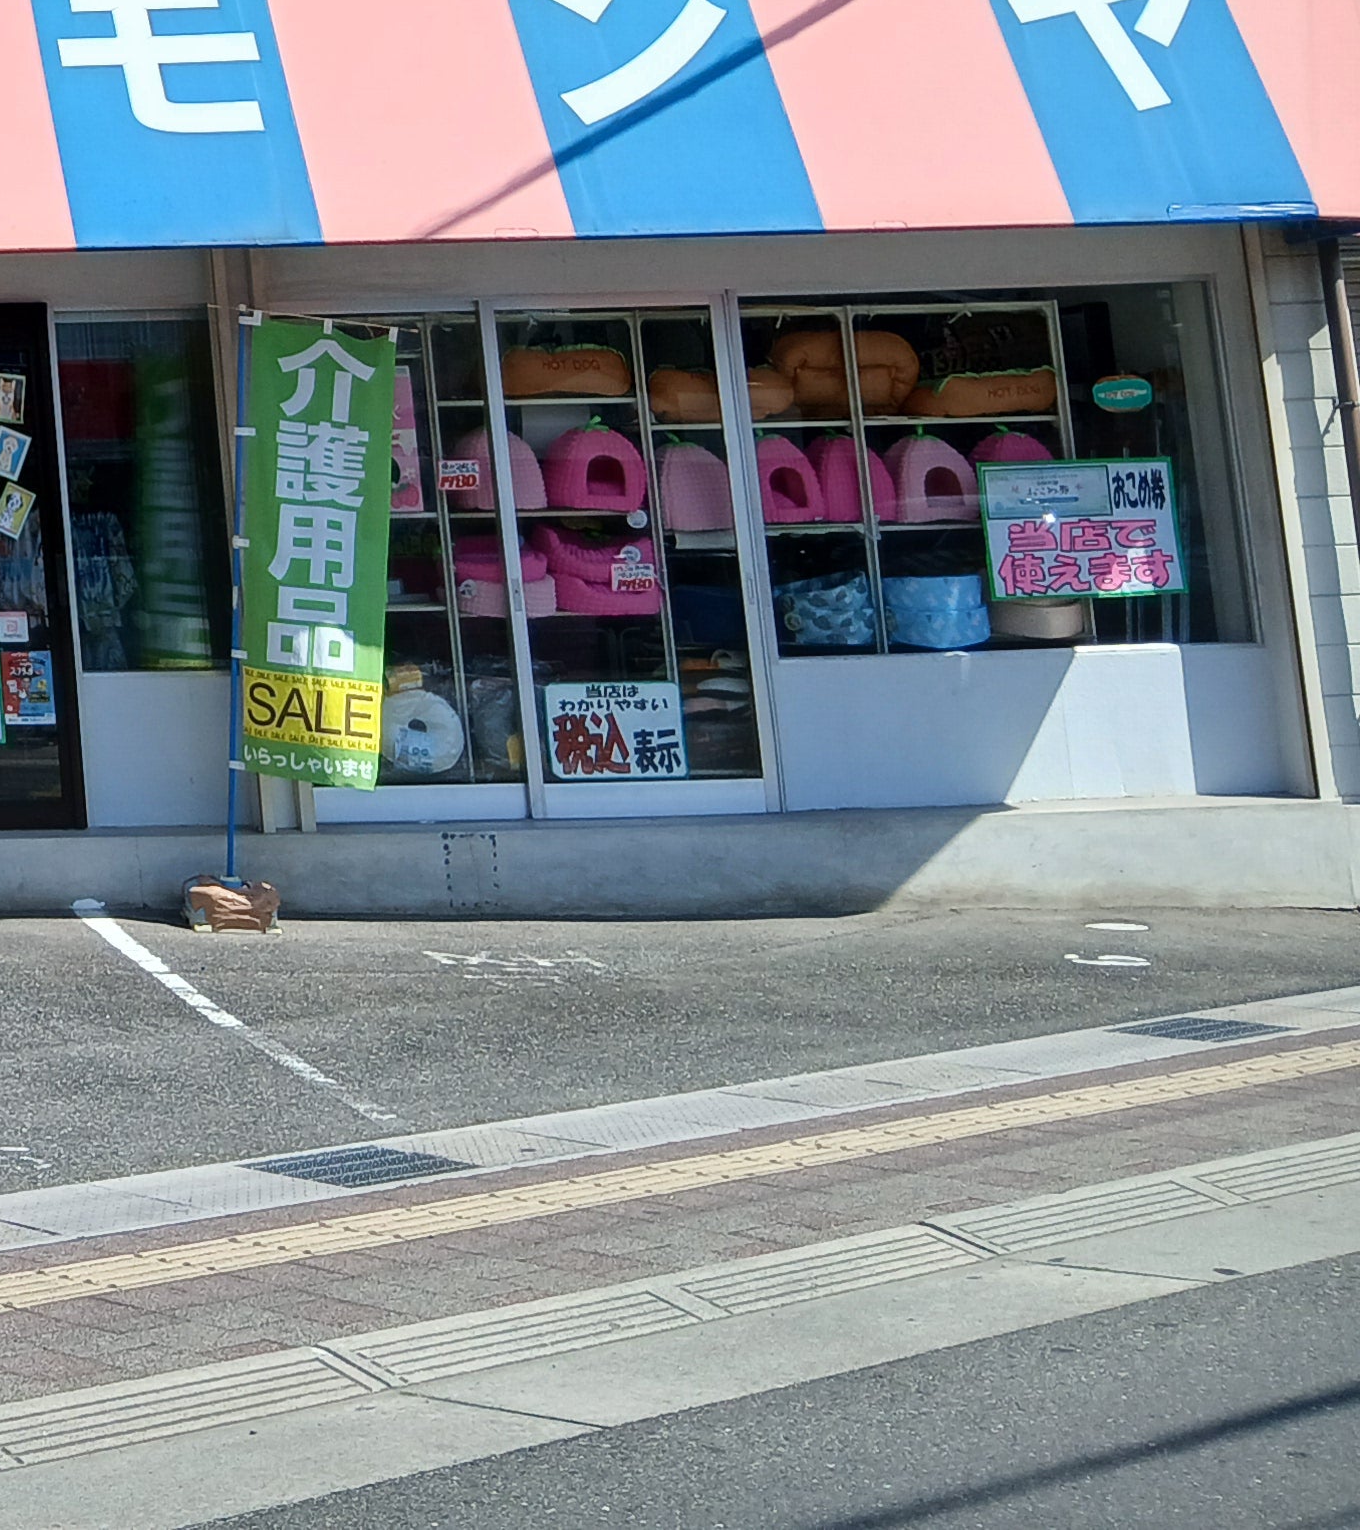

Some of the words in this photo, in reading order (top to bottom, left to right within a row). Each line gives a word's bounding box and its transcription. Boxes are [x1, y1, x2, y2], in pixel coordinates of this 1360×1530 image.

[542, 359, 566, 370] HOT
[987, 385, 1013, 398] HOT
[266, 337, 377, 673] 介護用品
[1112, 468, 1166, 510] おこめ券
[1008, 518, 1157, 553] 当店で
[998, 549, 1174, 595] 使えます
[558, 698, 669, 712] わかりやすい
[585, 683, 640, 699] 当店は
[247, 682, 374, 739] SALE
[552, 710, 682, 775] 税込表示
[244, 744, 373, 780] いらっしゃいませ
